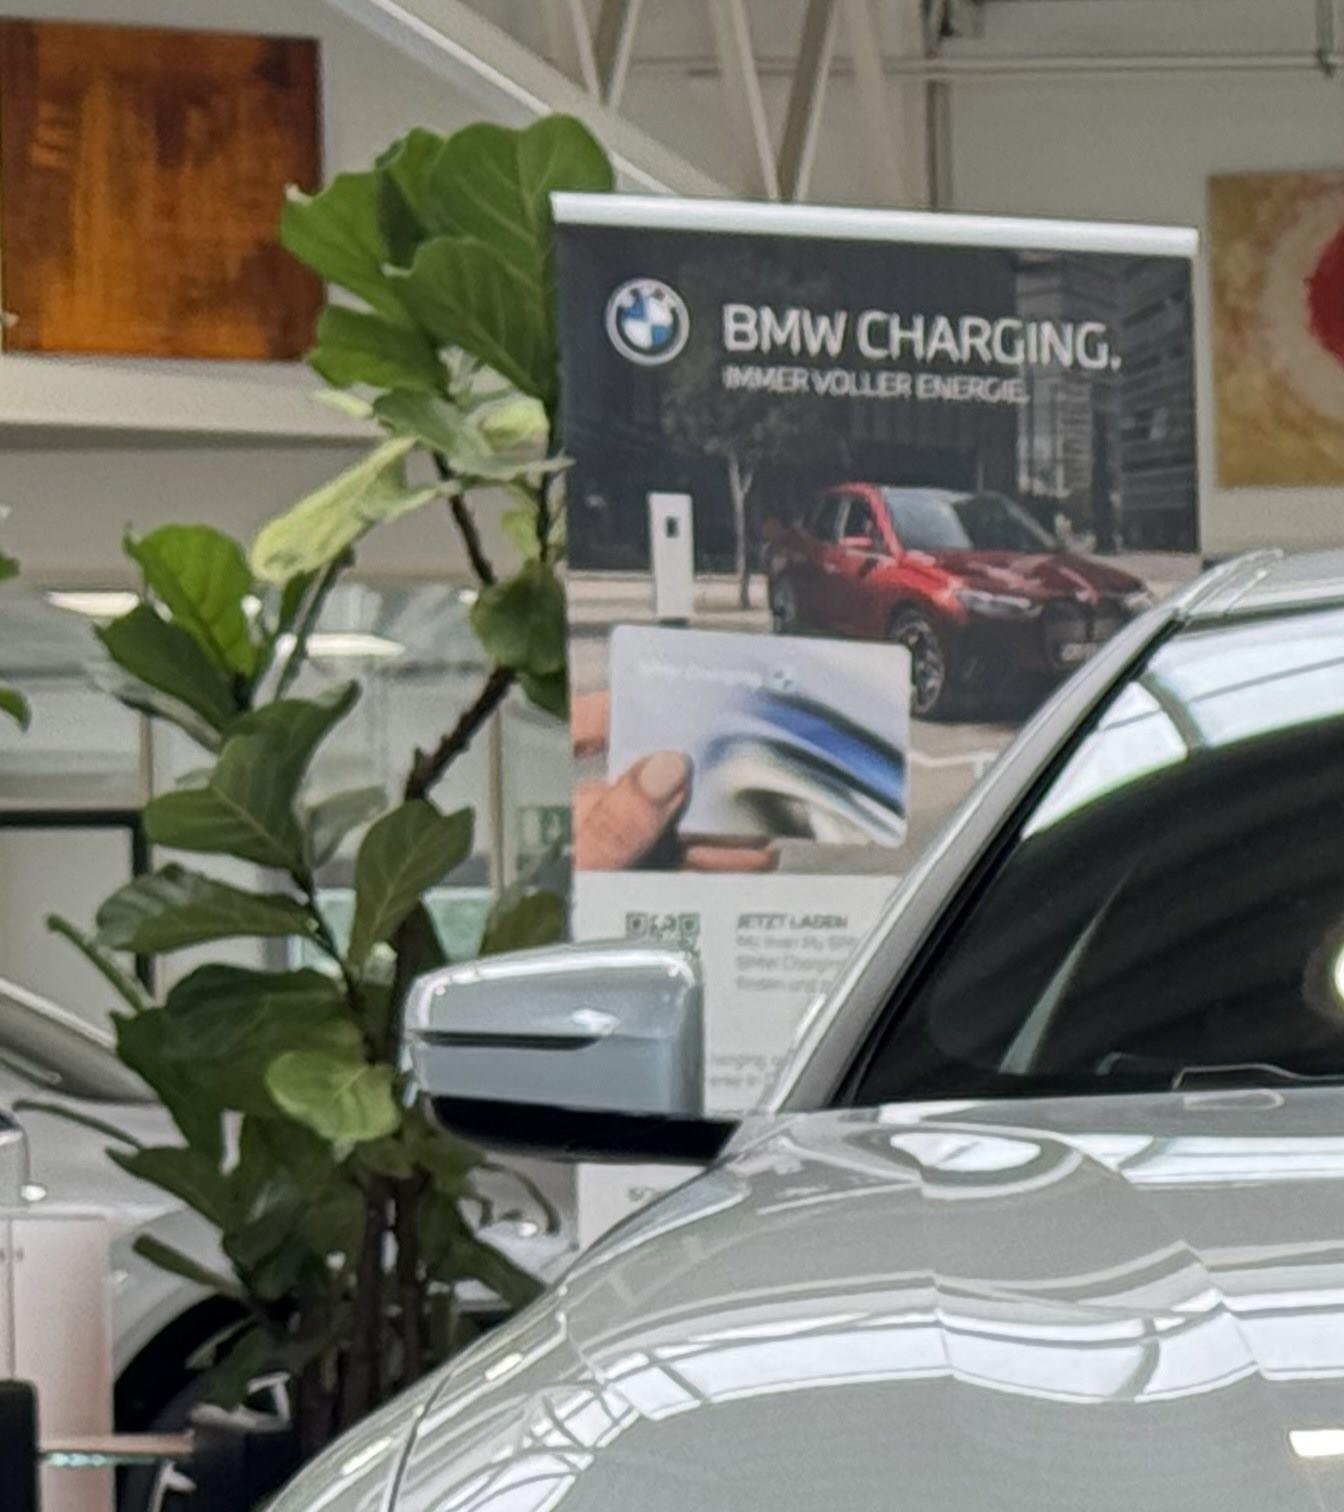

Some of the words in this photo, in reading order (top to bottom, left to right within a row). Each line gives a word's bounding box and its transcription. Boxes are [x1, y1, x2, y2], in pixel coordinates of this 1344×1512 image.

[722, 303, 848, 356] BMW
[856, 309, 1122, 372] CHARGING.
[722, 365, 810, 392] IMMER
[811, 367, 912, 397] VOLLER
